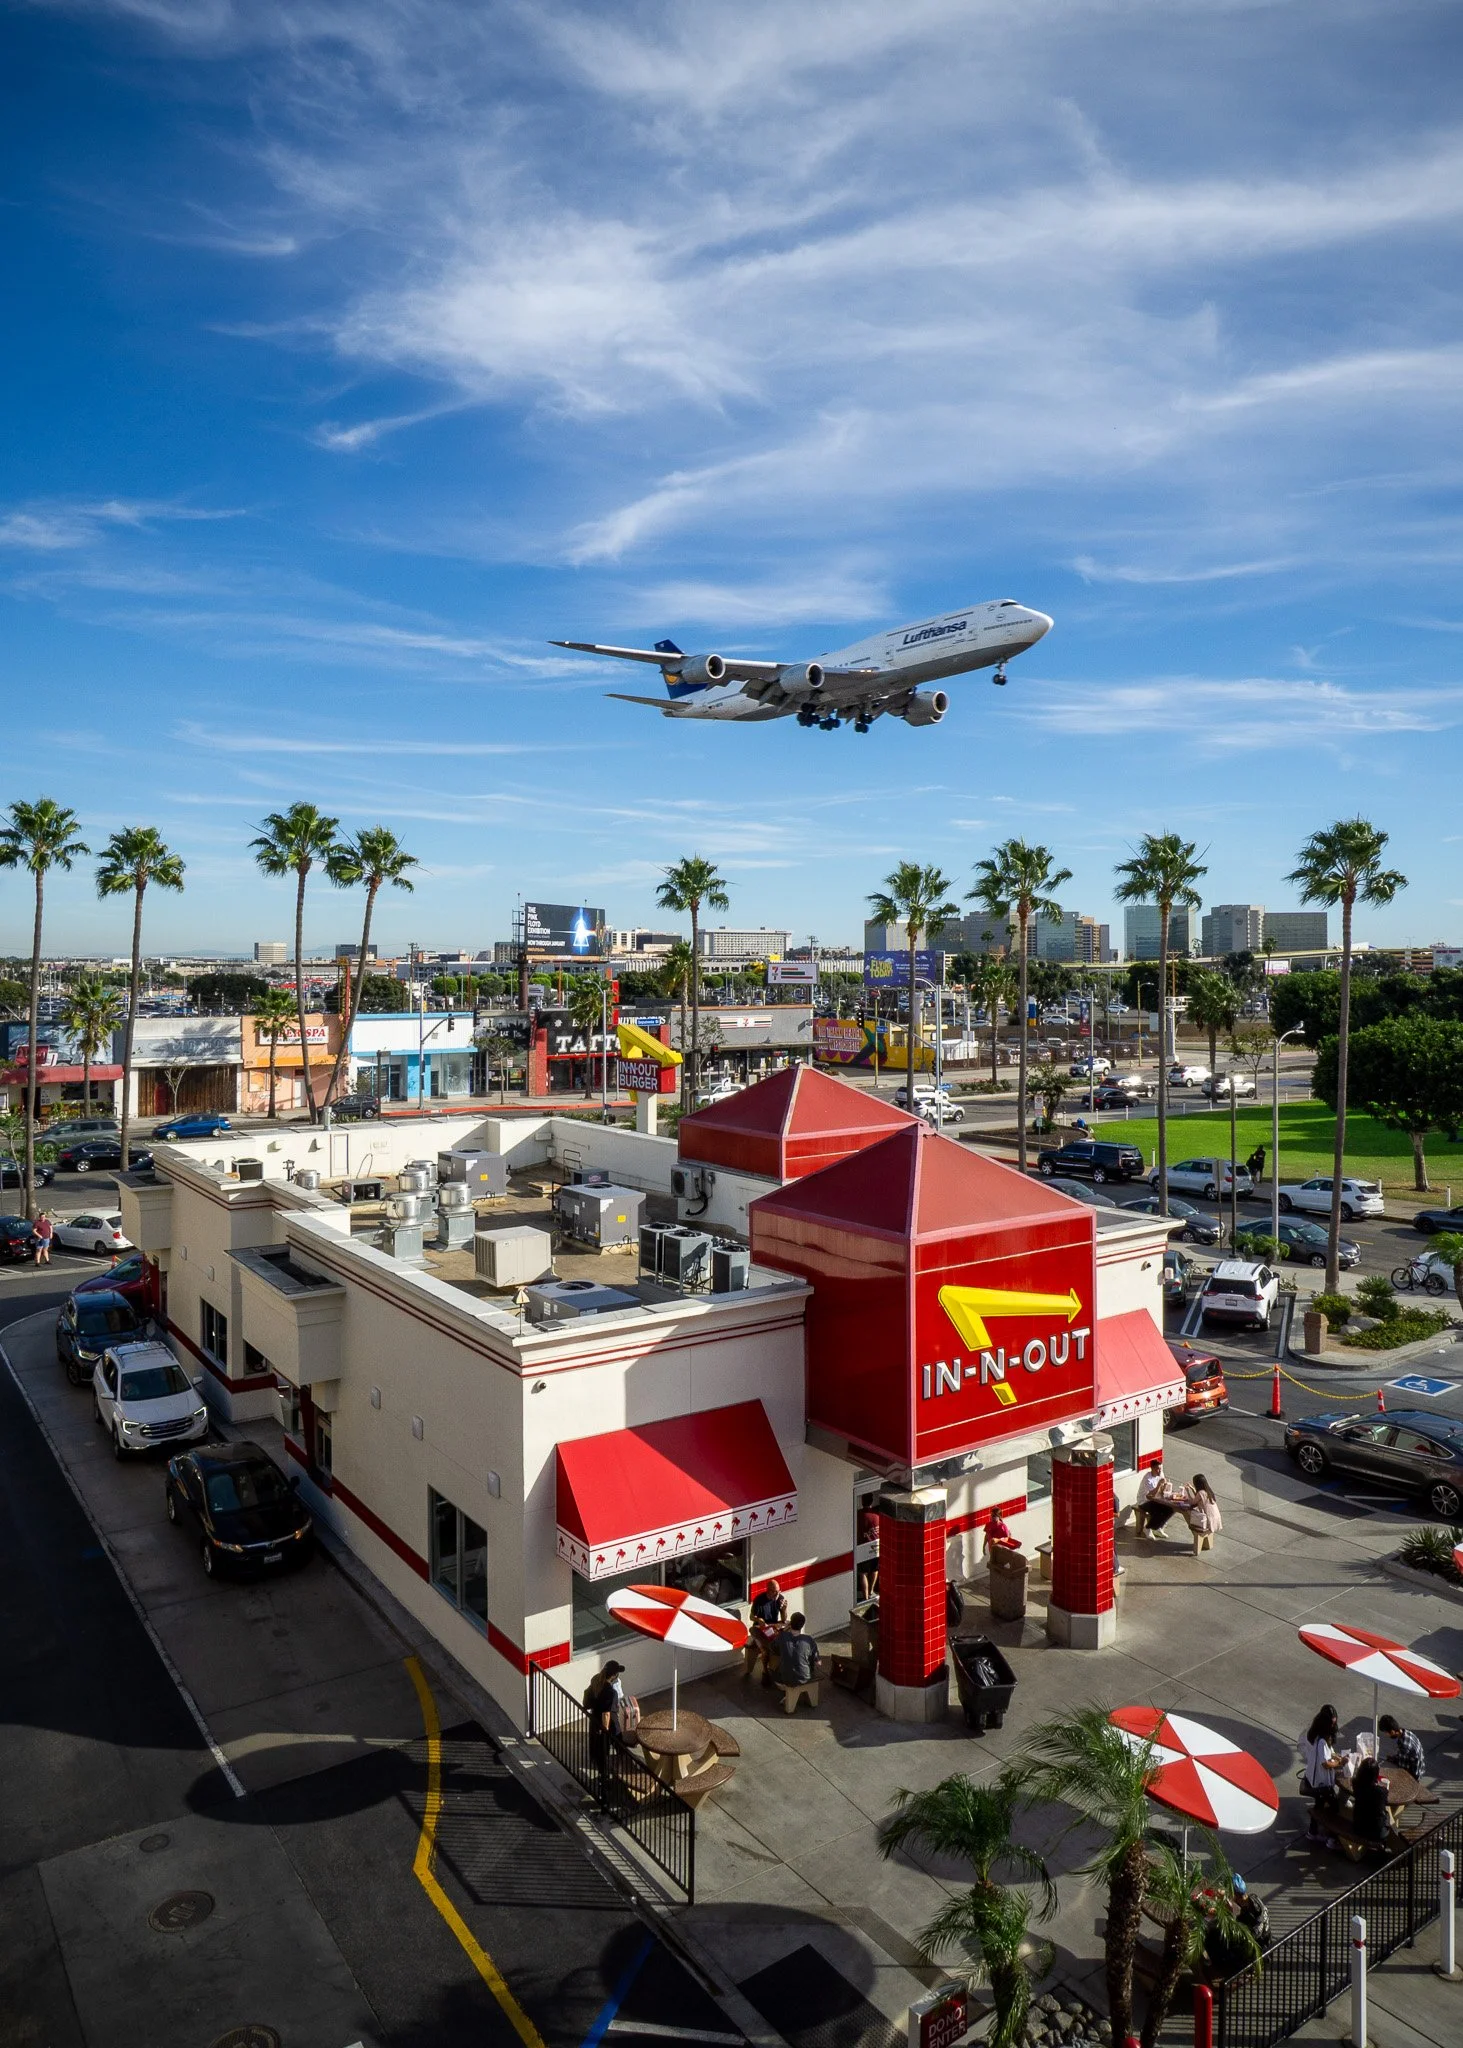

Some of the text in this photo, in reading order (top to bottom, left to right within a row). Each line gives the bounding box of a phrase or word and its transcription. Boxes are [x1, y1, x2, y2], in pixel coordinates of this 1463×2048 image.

[903, 620, 967, 645] Lufthansa
[871, 960, 893, 971] FLYING
[306, 1028, 326, 1037] SPA
[619, 1061, 659, 1077] IN-N-OUT
[619, 1073, 658, 1090] BURGER
[922, 1327, 1091, 1400] IN-N-OUT
[929, 2018, 945, 2037] DO
[929, 2021, 966, 2048] ENTER
